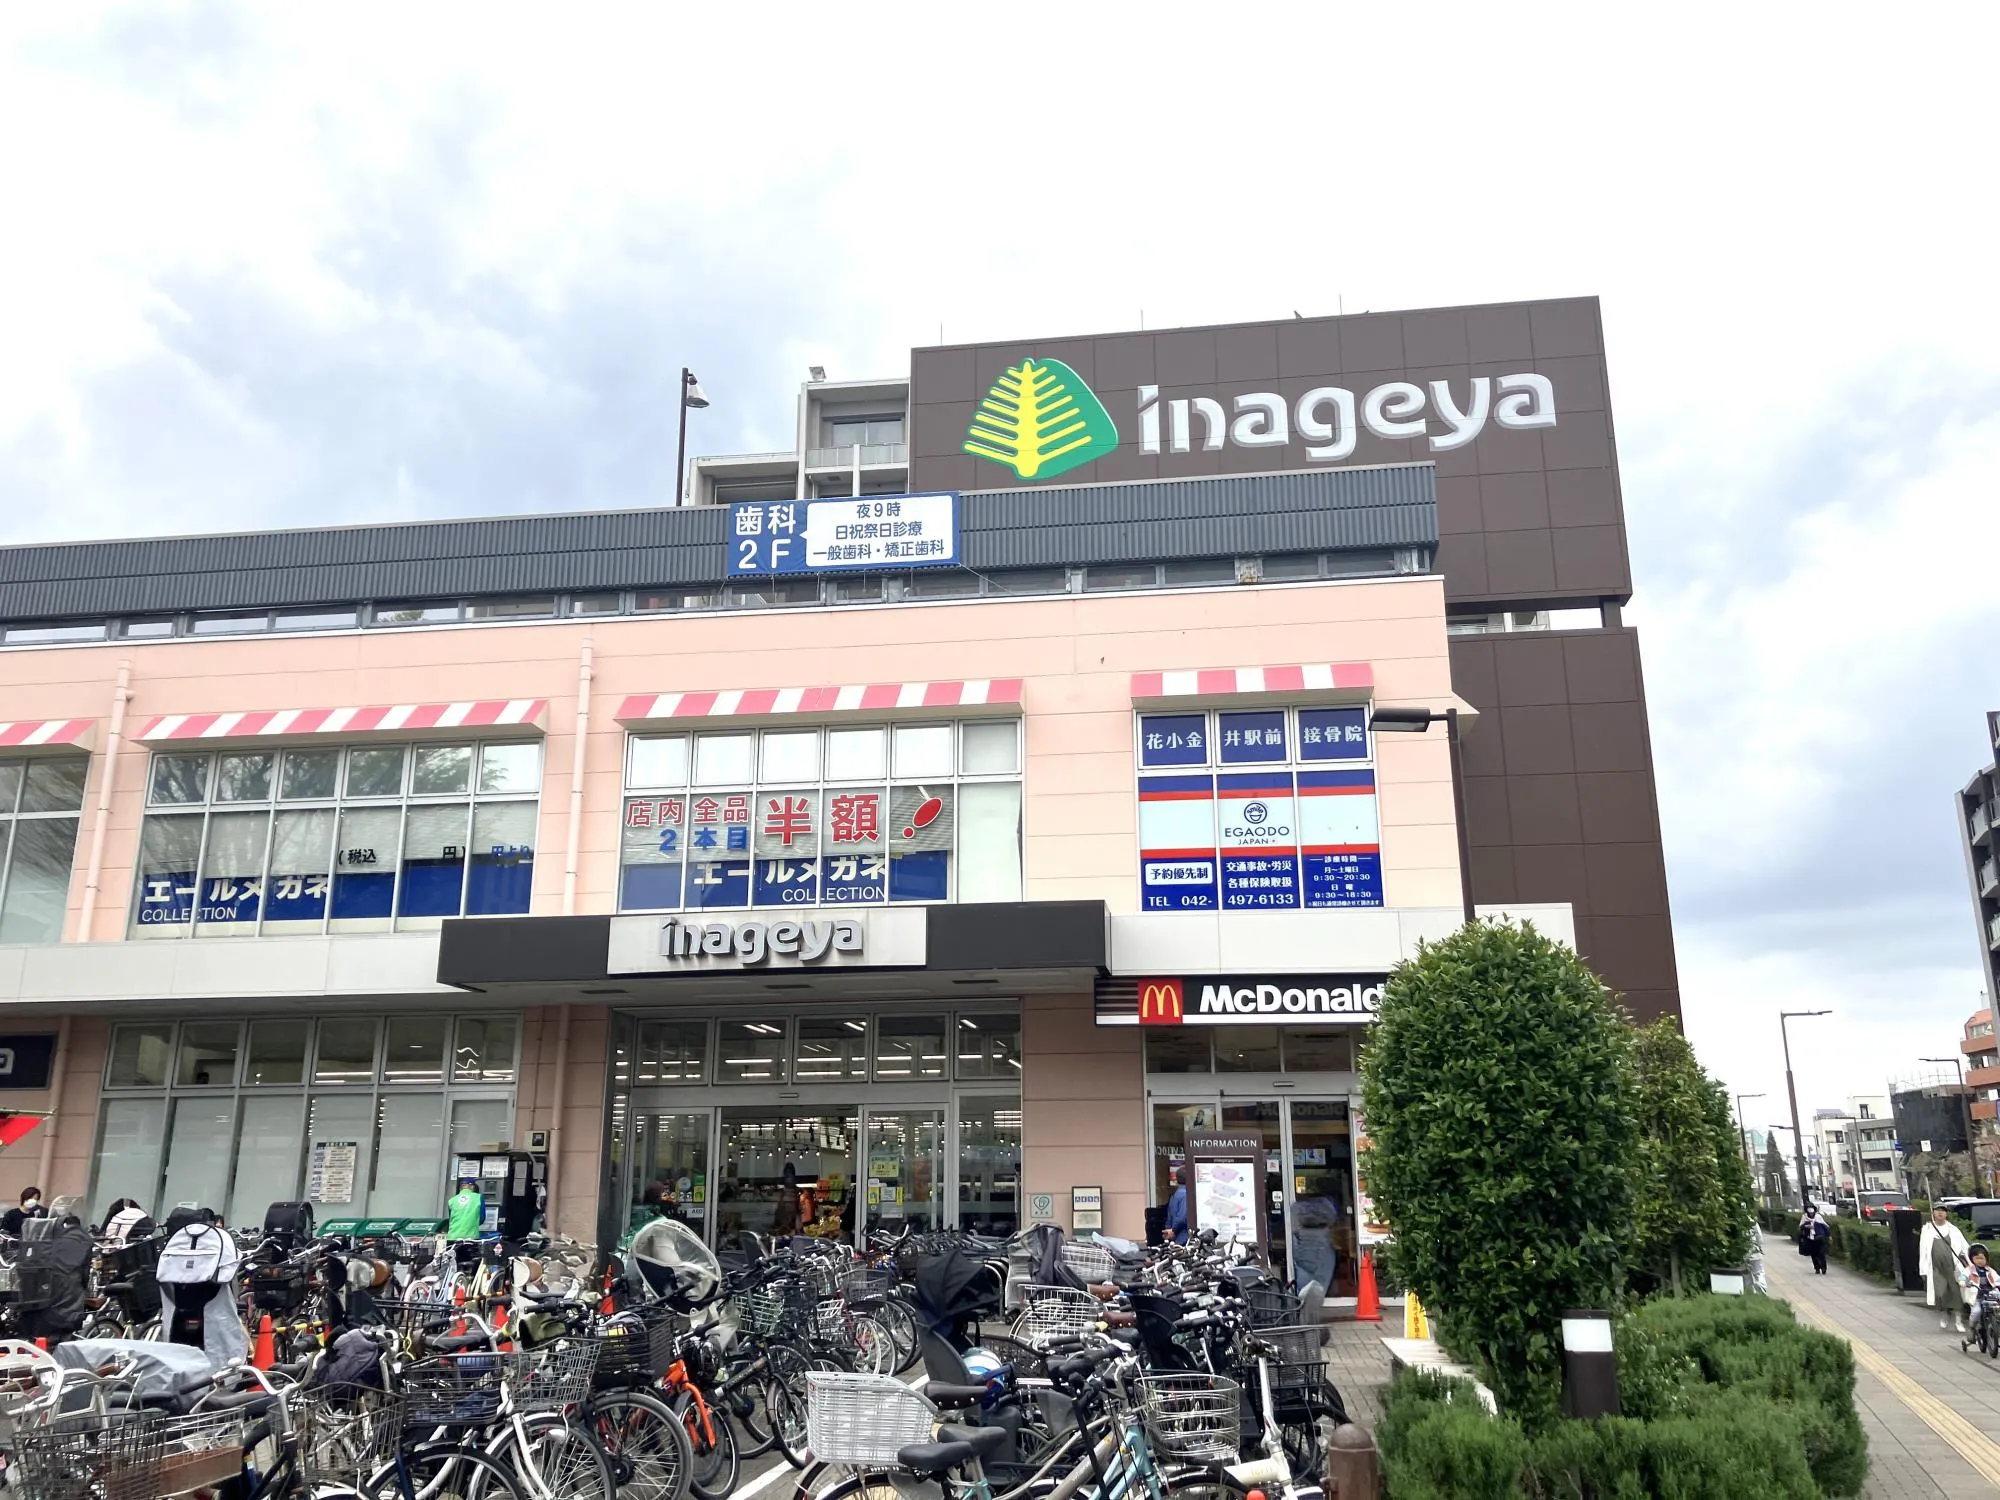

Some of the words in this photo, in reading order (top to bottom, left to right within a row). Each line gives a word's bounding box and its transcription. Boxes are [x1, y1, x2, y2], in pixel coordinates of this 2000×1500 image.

[1137, 372, 1557, 462] inageya
[856, 501, 901, 519] 夜9時
[735, 503, 797, 536] 歯科
[835, 521, 922, 540] 日祝祭日診療
[738, 538, 792, 569] 2F
[813, 539, 944, 560] 一般歯科・矯正歯科
[659, 825, 748, 851] 2本目
[1224, 826, 1289, 838] EGAODO
[1238, 838, 1269, 846] JAPAN
[693, 854, 886, 885] エールメガネ
[1150, 867, 1208, 880] 予約優先制
[1226, 860, 1292, 872] 交通事故・労災
[144, 876, 329, 903] エールメガネ
[1228, 877, 1292, 888] 各種保険取扱
[782, 886, 886, 903] COLECTION
[1148, 896, 1171, 906] TEL
[141, 906, 237, 923] COLLETION
[659, 915, 863, 965] inageya
[1190, 1139, 1258, 1149] INFORMATION
